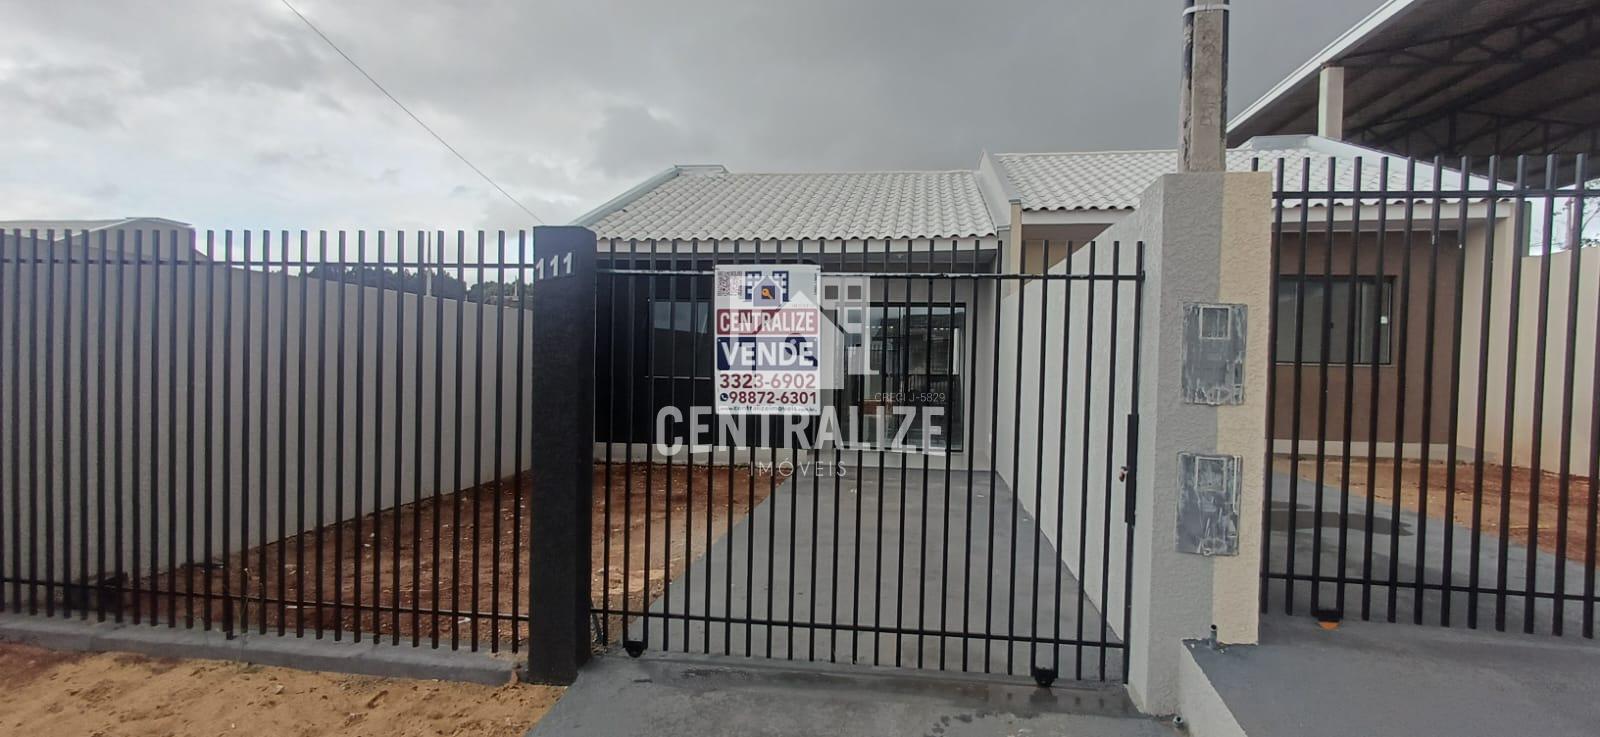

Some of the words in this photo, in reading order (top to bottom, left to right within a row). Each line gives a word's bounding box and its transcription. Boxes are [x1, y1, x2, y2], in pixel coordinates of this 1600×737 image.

[535, 251, 573, 280] 111
[719, 311, 815, 333] CENTRALIZE
[721, 341, 815, 367] VENDE
[719, 373, 816, 389] 3323-6902
[728, 391, 817, 405] 98872-6301
